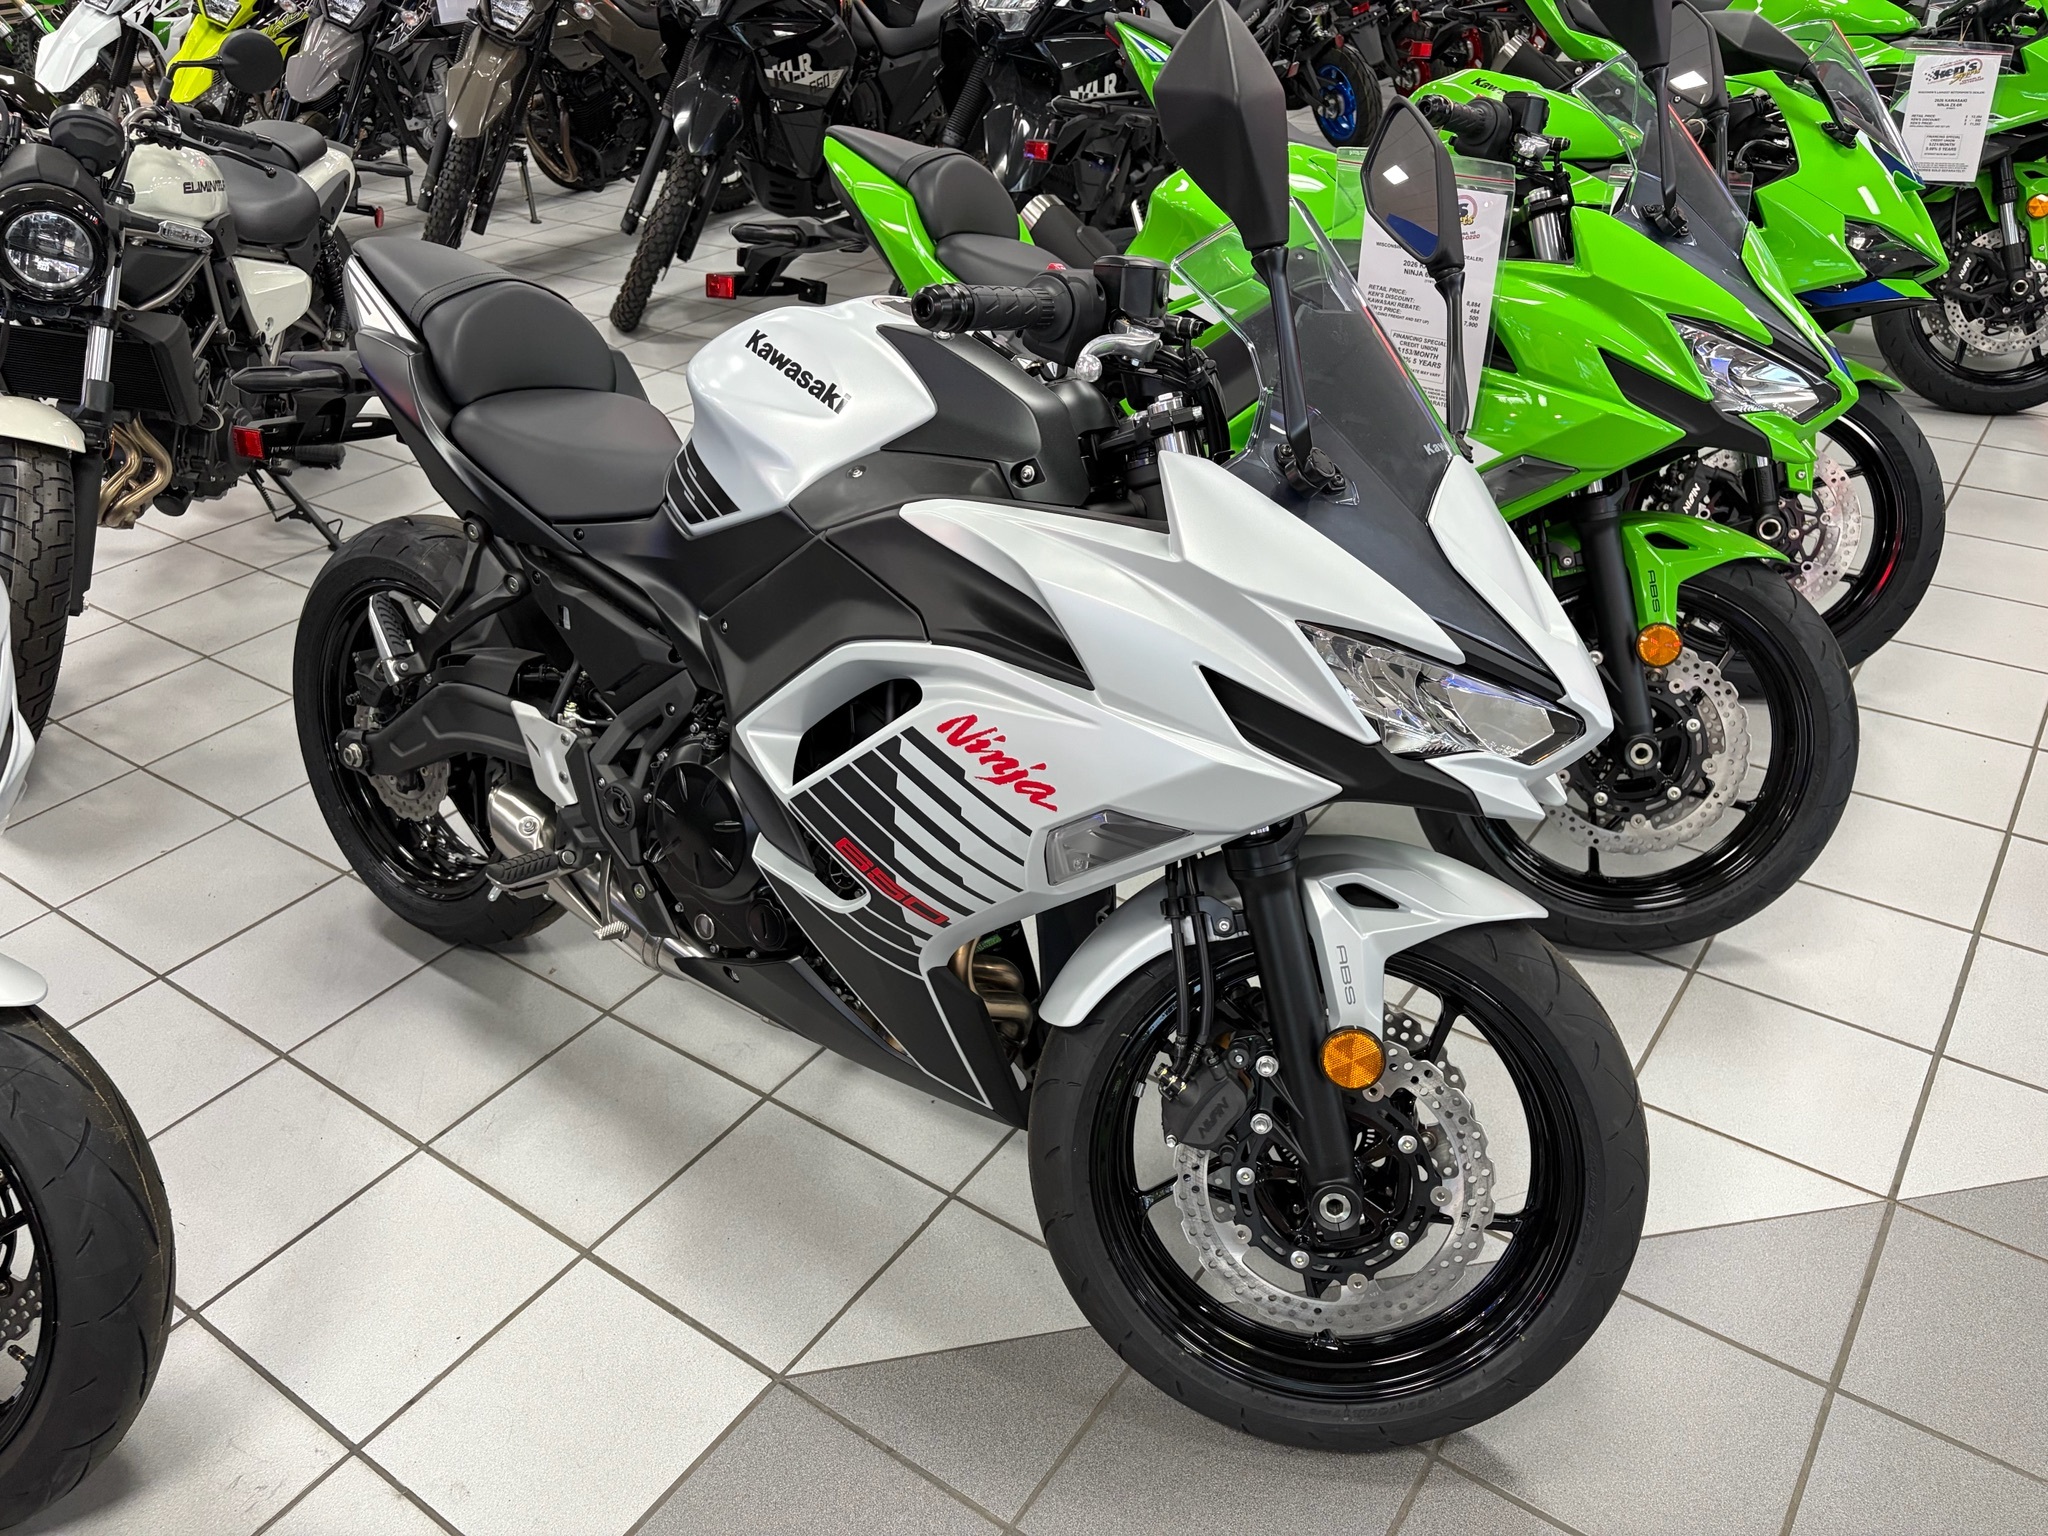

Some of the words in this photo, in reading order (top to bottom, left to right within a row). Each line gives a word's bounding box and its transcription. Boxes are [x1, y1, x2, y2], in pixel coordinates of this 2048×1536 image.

[1403, 259, 1416, 268] 2026
[1403, 268, 1424, 278] NINJA
[1368, 284, 1388, 293] RETAIL
[1389, 287, 1408, 295] PRICE:
[1368, 291, 1384, 299] KEN'S
[1385, 293, 1416, 303] DISCOUNT:
[1367, 297, 1397, 307] KAWASAKI
[1397, 302, 1422, 311] REBATE:
[1383, 306, 1402, 314] PRICE:
[1392, 332, 1423, 343] FINANCING
[1423, 338, 1448, 348] SPECIAL
[1399, 340, 1419, 350] CREDIT
[1420, 344, 1439, 352] UNION
[1418, 359, 1442, 369] YEARS
[744, 328, 852, 415] Kawasaki
[1647, 569, 1661, 613] ABS
[936, 714, 1058, 812] Ninja
[834, 837, 951, 926] 650
[1336, 944, 1356, 1006] ABS
